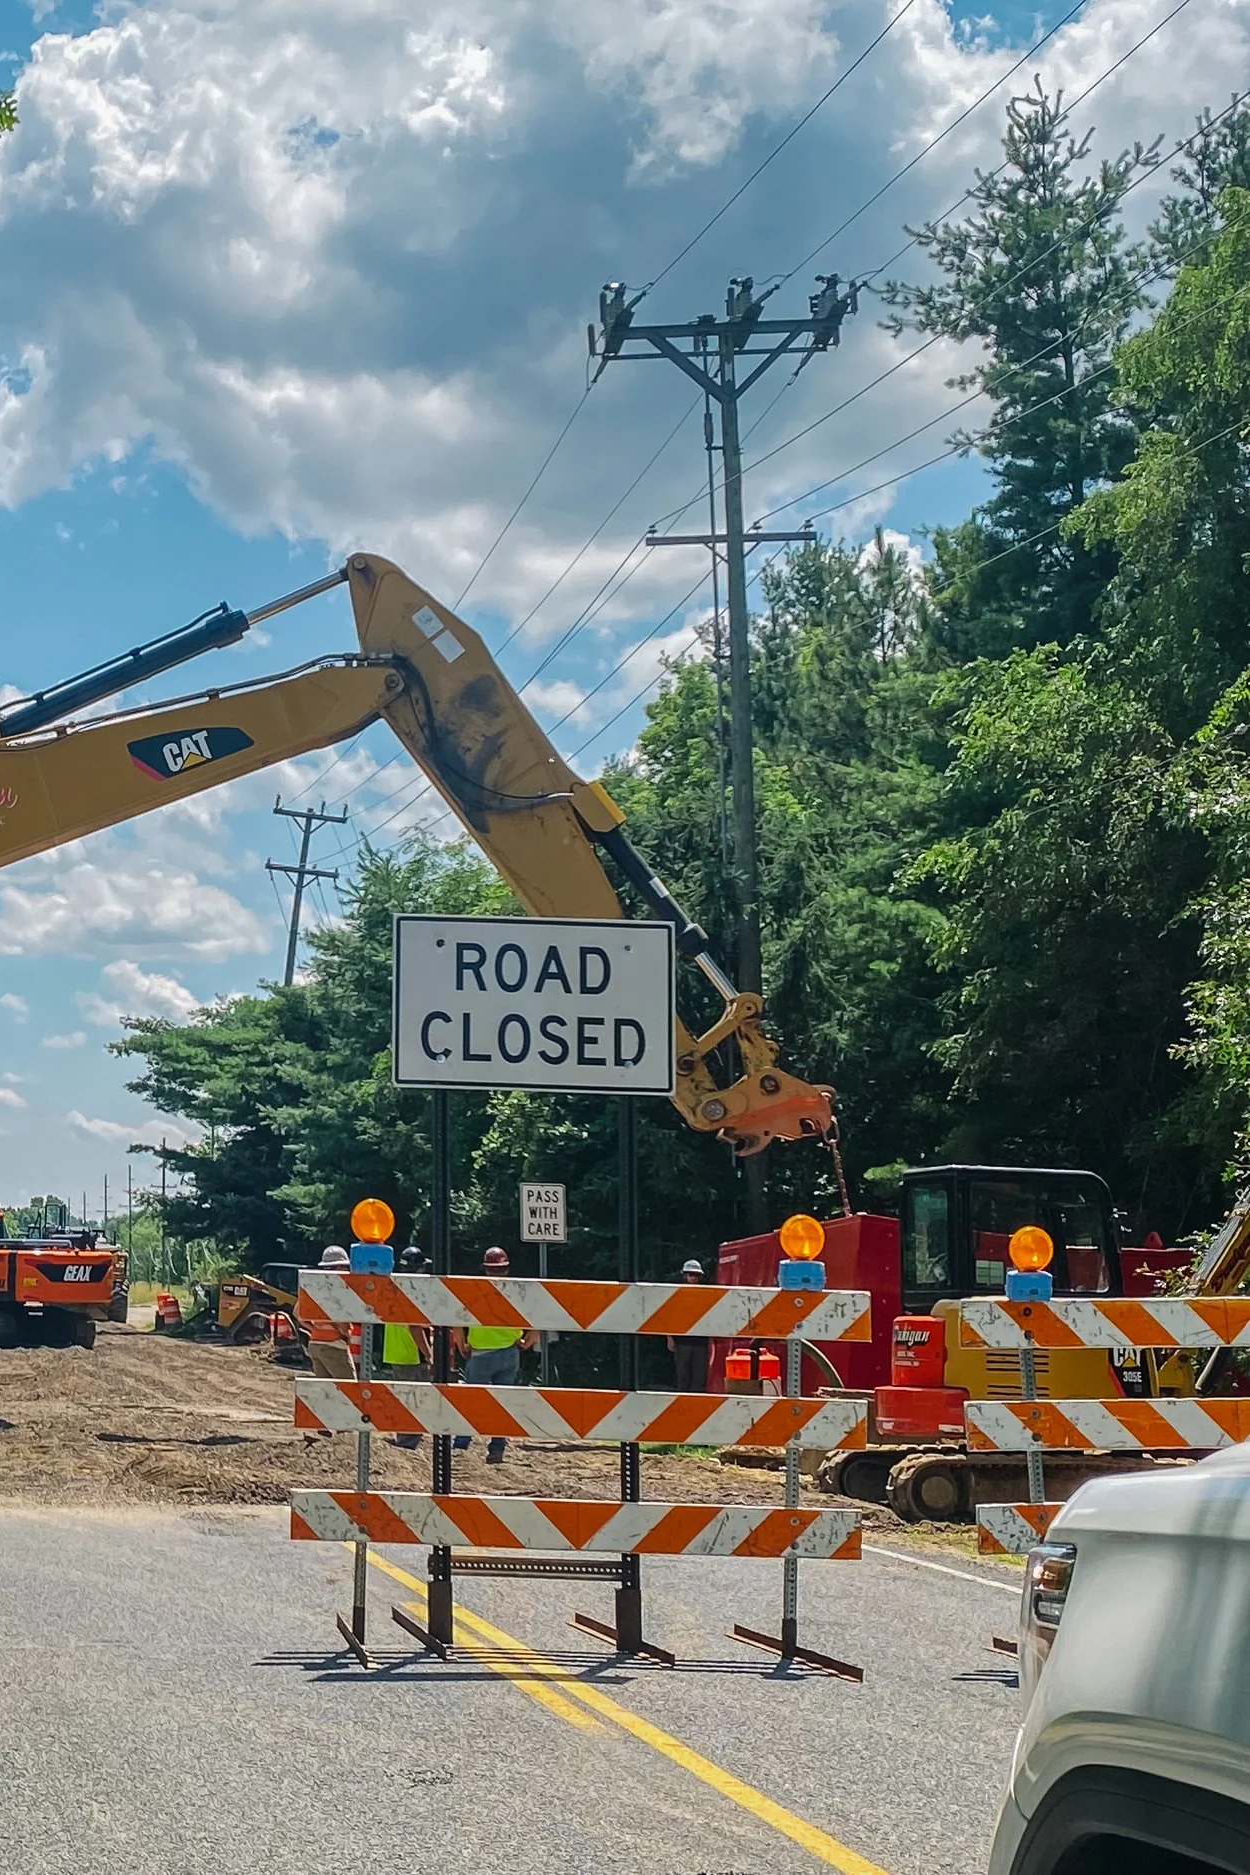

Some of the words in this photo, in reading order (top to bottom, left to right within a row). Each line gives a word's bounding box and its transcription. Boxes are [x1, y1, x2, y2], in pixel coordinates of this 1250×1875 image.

[162, 730, 212, 772] CAT
[456, 942, 611, 995] ROAD
[420, 1010, 647, 1067] CLOSED
[527, 1190, 559, 1203] PASS
[529, 1206, 558, 1219] WITH
[528, 1223, 560, 1236] CARE
[63, 1265, 92, 1282] GEAX
[1113, 1347, 1142, 1367] CAT
